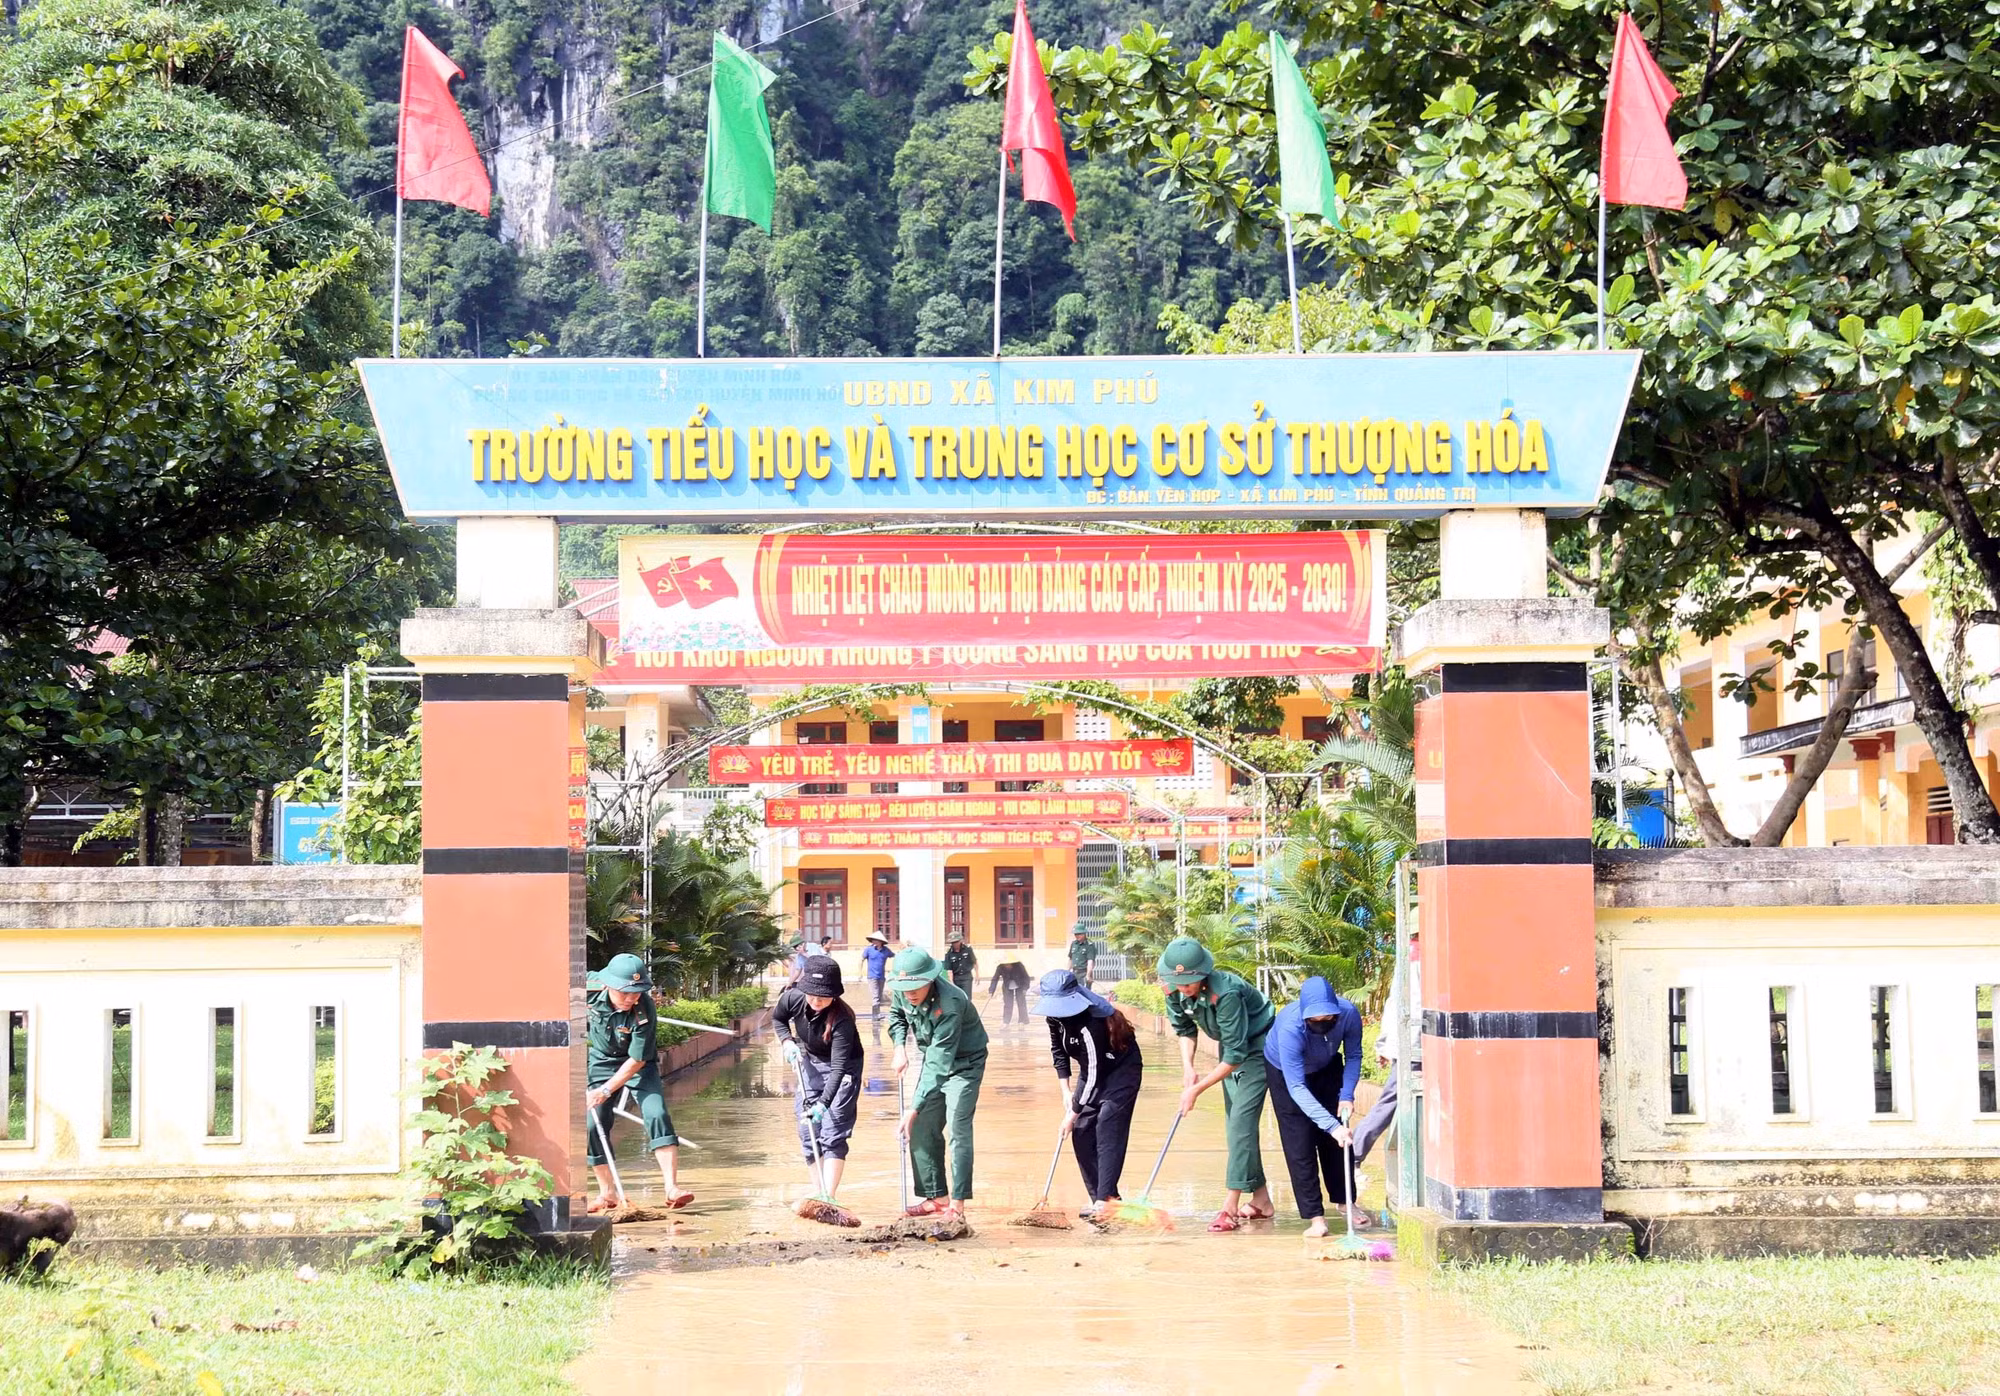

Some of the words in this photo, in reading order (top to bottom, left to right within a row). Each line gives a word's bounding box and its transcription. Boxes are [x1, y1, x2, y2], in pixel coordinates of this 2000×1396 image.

[843, 378, 933, 406] UBND
[950, 371, 996, 406] XÃ
[1014, 378, 1075, 405] KIM
[1093, 370, 1159, 405] PHÚ
[467, 412, 633, 483] TRƯỜNG
[646, 405, 735, 481] TIỂU
[750, 426, 832, 491] HỌC
[845, 413, 897, 479] VÀ
[908, 425, 1044, 479] TRUNG
[1056, 423, 1138, 487] HỌC
[1152, 419, 1208, 477] CƠ
[1219, 400, 1276, 475] SỞ
[1287, 416, 1451, 484] THƯỢNG
[1465, 408, 1549, 474] HÓA
[1118, 485, 1150, 503] BẢN
[1156, 486, 1186, 503] YÊN
[1191, 488, 1221, 506] HỢP
[1241, 485, 1263, 503] XÃ
[1268, 488, 1298, 503] KIM
[1304, 485, 1335, 503] PHÚ
[1354, 483, 1389, 503] TỈNH
[1394, 483, 1446, 503] QUẢNG
[1452, 486, 1476, 504] TRỊ
[792, 553, 838, 626] NHIỆT
[842, 553, 875, 626] LIỆT
[879, 552, 922, 614] CHÀO
[927, 552, 976, 614] MỪNG
[979, 562, 1007, 625] ĐẠI
[1011, 552, 1038, 625] HỘI
[1042, 546, 1087, 613] ĐẢNG
[1091, 551, 1123, 613] CÁC
[1127, 545, 1162, 619] CẤP,
[1166, 551, 1218, 624] NHIỆM
[1223, 551, 1244, 613] KỲ
[1248, 562, 1287, 613] 2025
[1291, 586, 1298, 596] -
[1302, 562, 1347, 613] 2030!
[760, 752, 796, 776] YÊU
[801, 750, 840, 777] TRẺ,
[846, 752, 881, 775] YÊU
[992, 753, 1021, 773] THI
[1026, 752, 1063, 772] ĐUA
[1068, 751, 1104, 775] DẠY
[1109, 744, 1142, 770] TỐT
[800, 804, 818, 823] HỌC
[820, 802, 837, 823] TẬP
[838, 802, 863, 819] SÁNG
[864, 803, 881, 822] TẠO
[828, 830, 868, 845] TRƯỜNG
[870, 832, 891, 847] HỌC
[957, 831, 978, 846] HỌC
